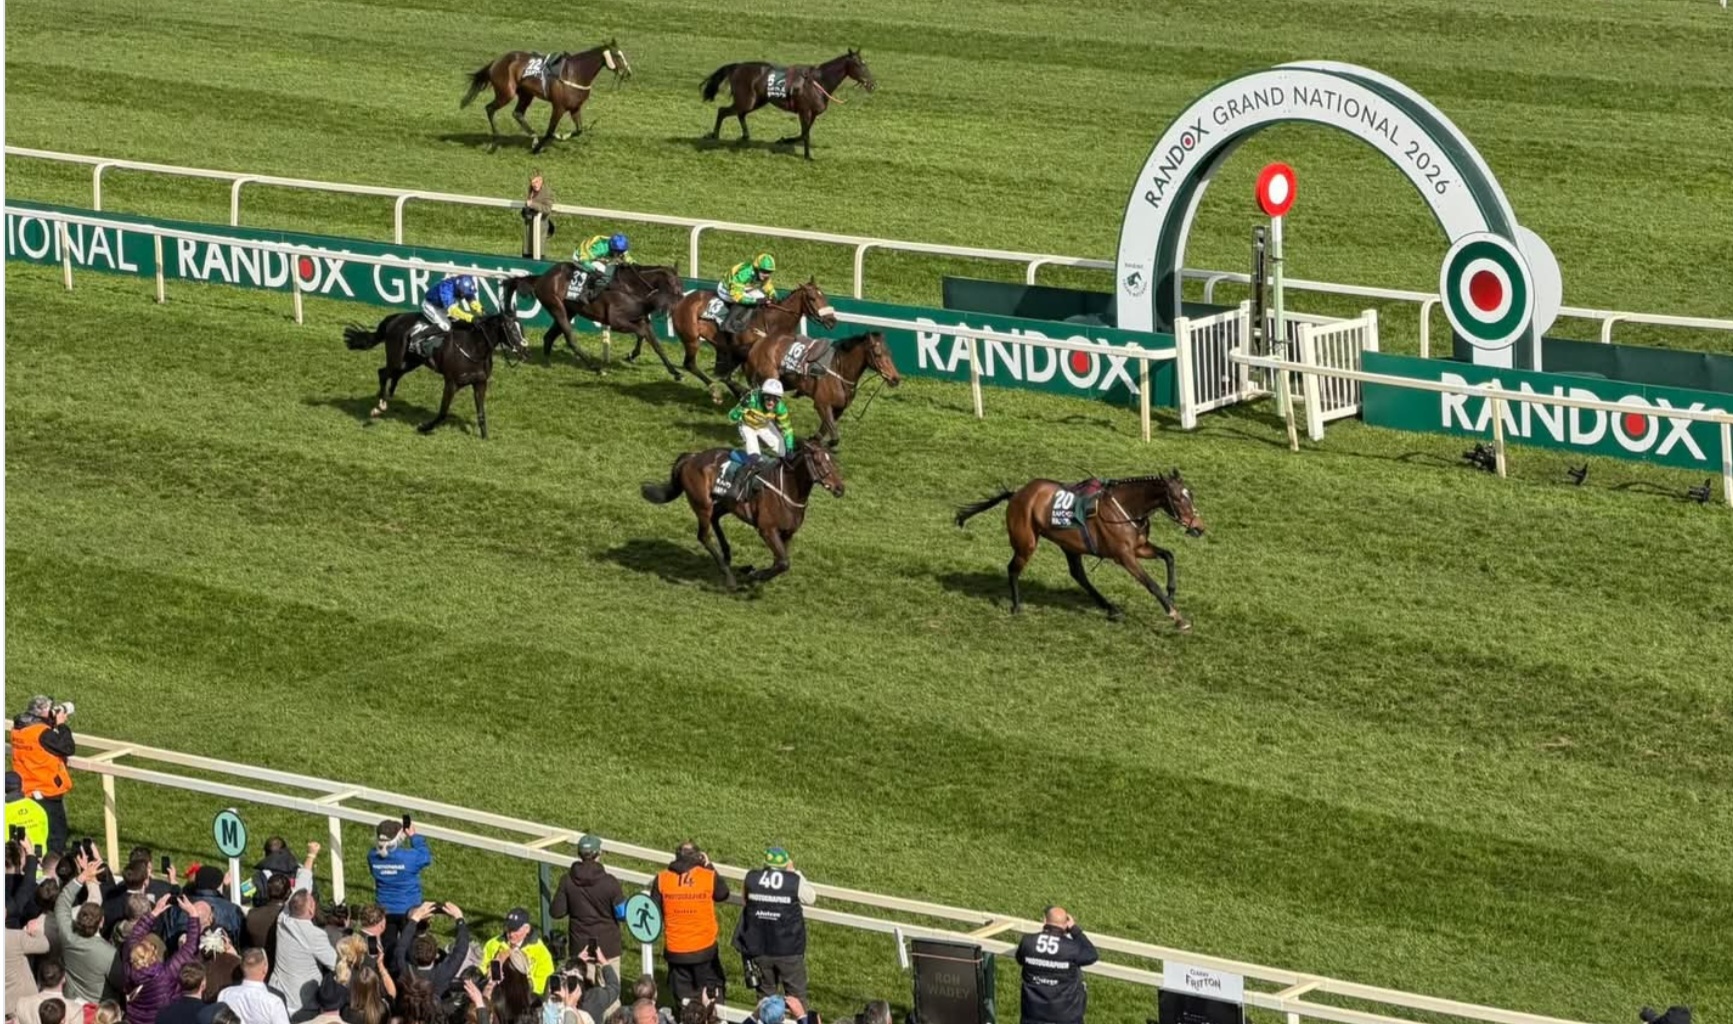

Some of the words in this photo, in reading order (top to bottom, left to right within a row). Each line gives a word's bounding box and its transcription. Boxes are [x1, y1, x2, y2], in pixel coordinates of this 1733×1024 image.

[1145, 117, 1210, 208] RANDOX
[1213, 86, 1285, 125] GRAND
[1293, 86, 1399, 146] NATIONAL
[1405, 140, 1451, 195] 2026
[176, 236, 355, 297] RANDOX
[915, 317, 1141, 396] RANDOX
[1441, 372, 1708, 461] RANDOX
[1053, 490, 1075, 510] 20
[221, 818, 239, 849] M
[678, 872, 695, 887] 14
[758, 870, 784, 890] 40
[1035, 934, 1060, 955] 55
